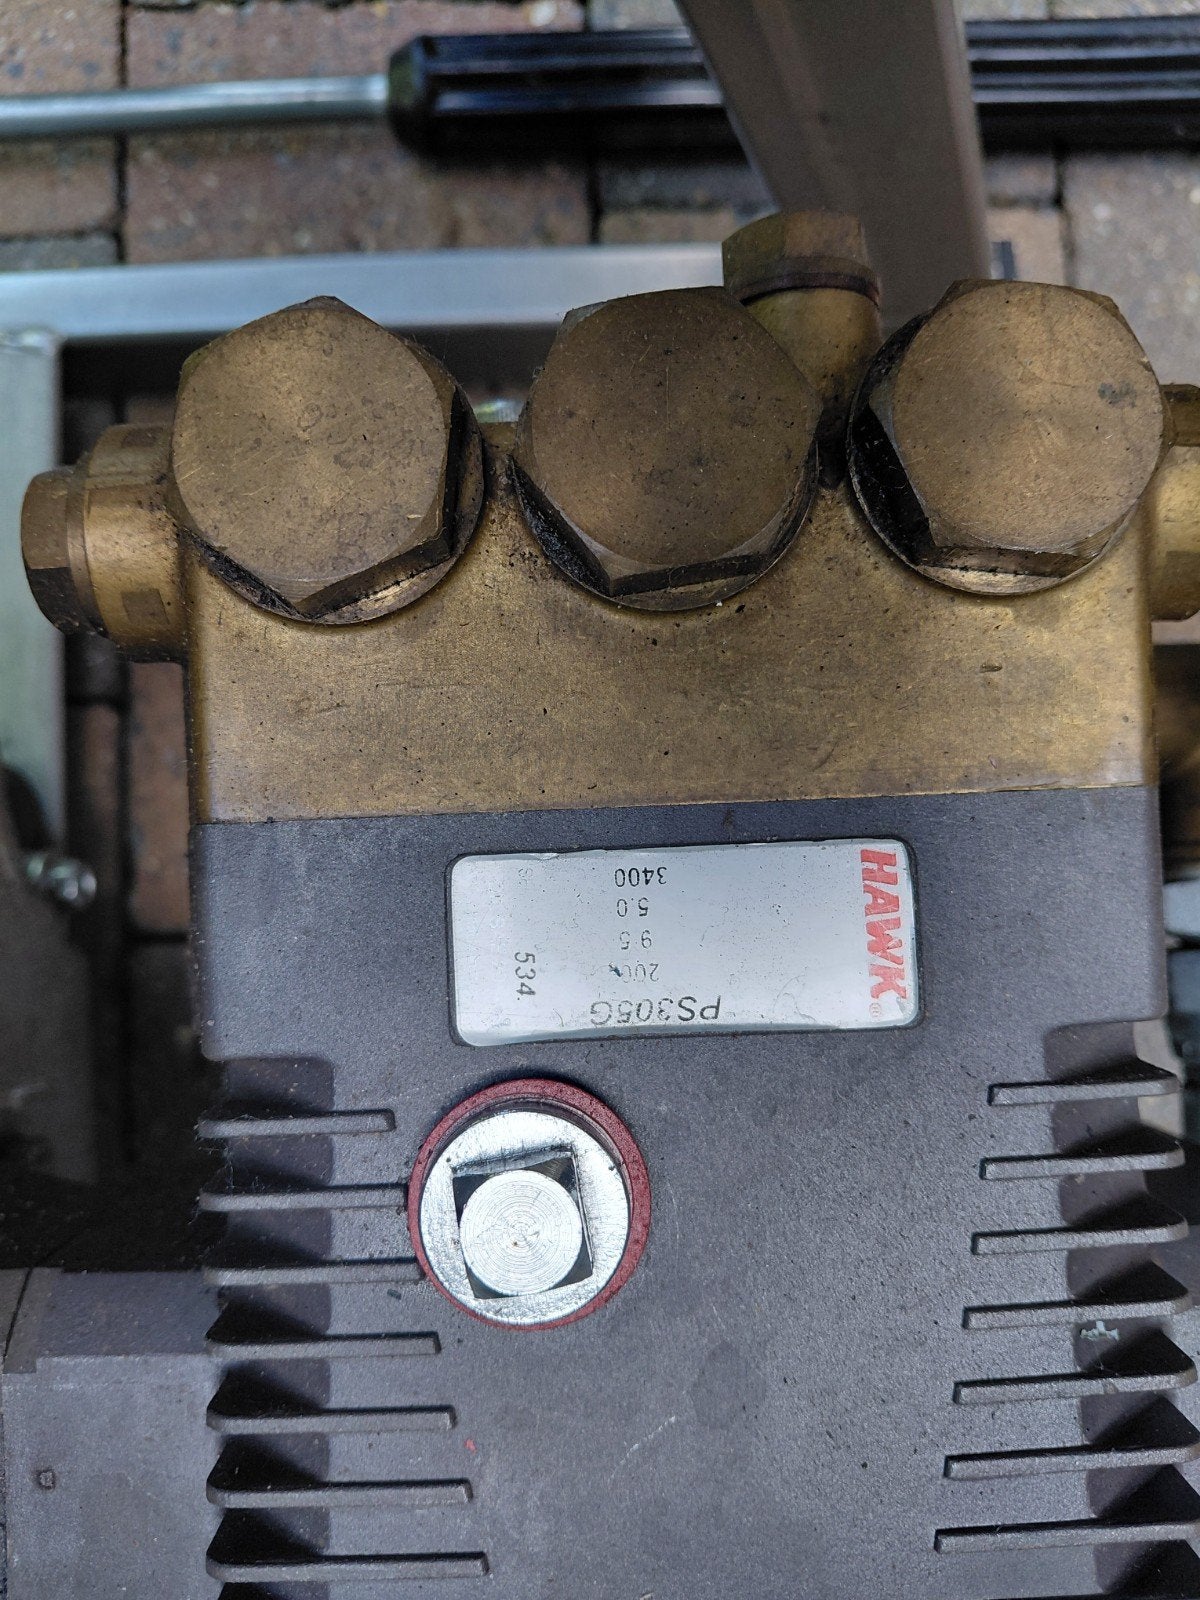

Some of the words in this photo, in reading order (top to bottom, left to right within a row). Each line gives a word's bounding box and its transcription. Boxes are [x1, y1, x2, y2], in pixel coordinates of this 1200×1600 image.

[614, 866, 667, 888] 3400
[616, 897, 649, 917] 5.0
[861, 849, 907, 999] HAWK
[590, 995, 721, 1026] PS305G
